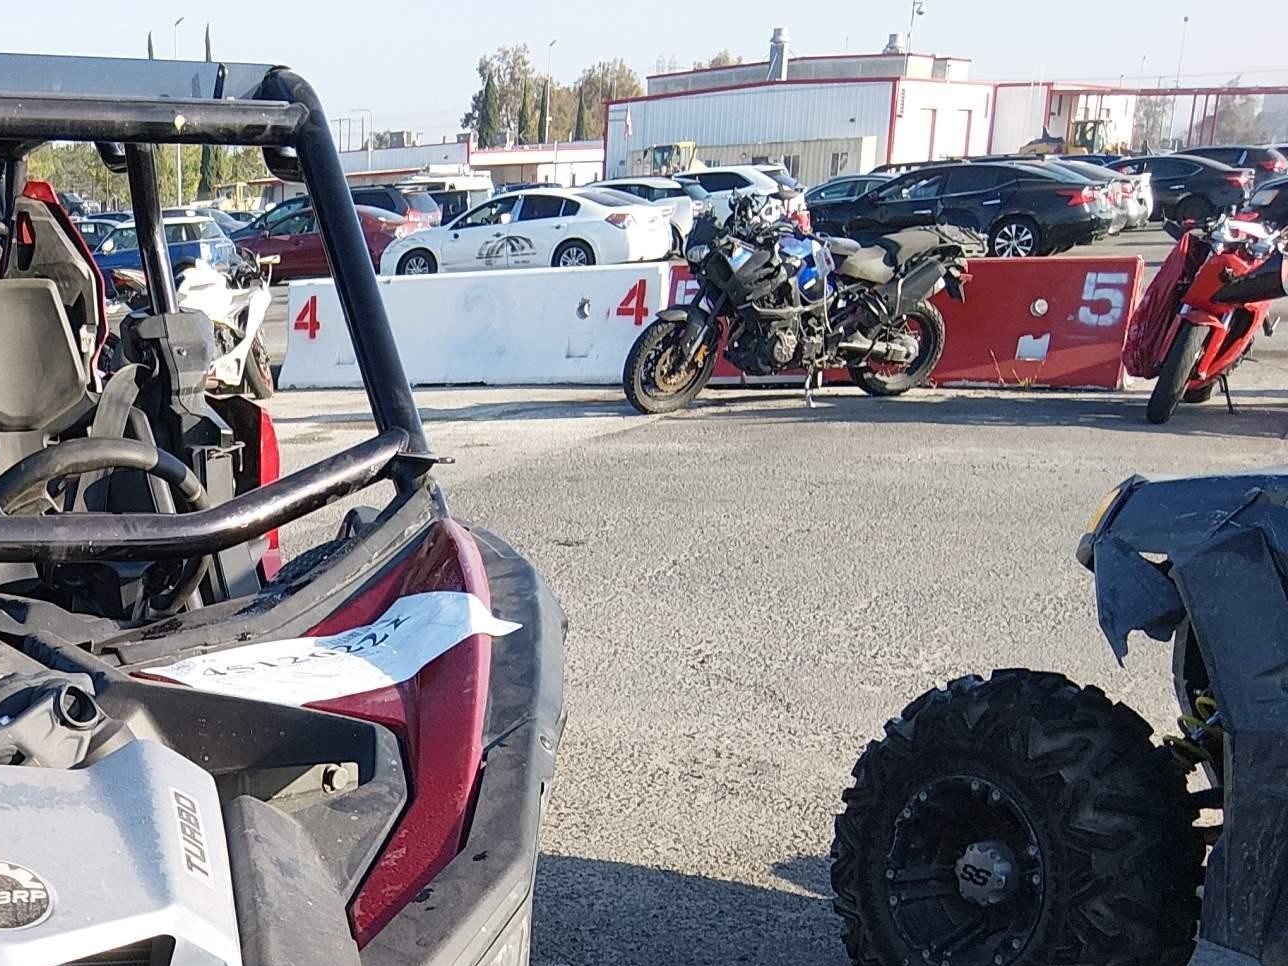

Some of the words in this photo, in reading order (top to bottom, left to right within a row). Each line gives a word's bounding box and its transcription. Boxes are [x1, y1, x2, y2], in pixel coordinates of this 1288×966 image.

[294, 295, 321, 339] 4
[616, 279, 649, 326] 4
[1078, 272, 1128, 326] 5
[175, 791, 210, 877] TURBO
